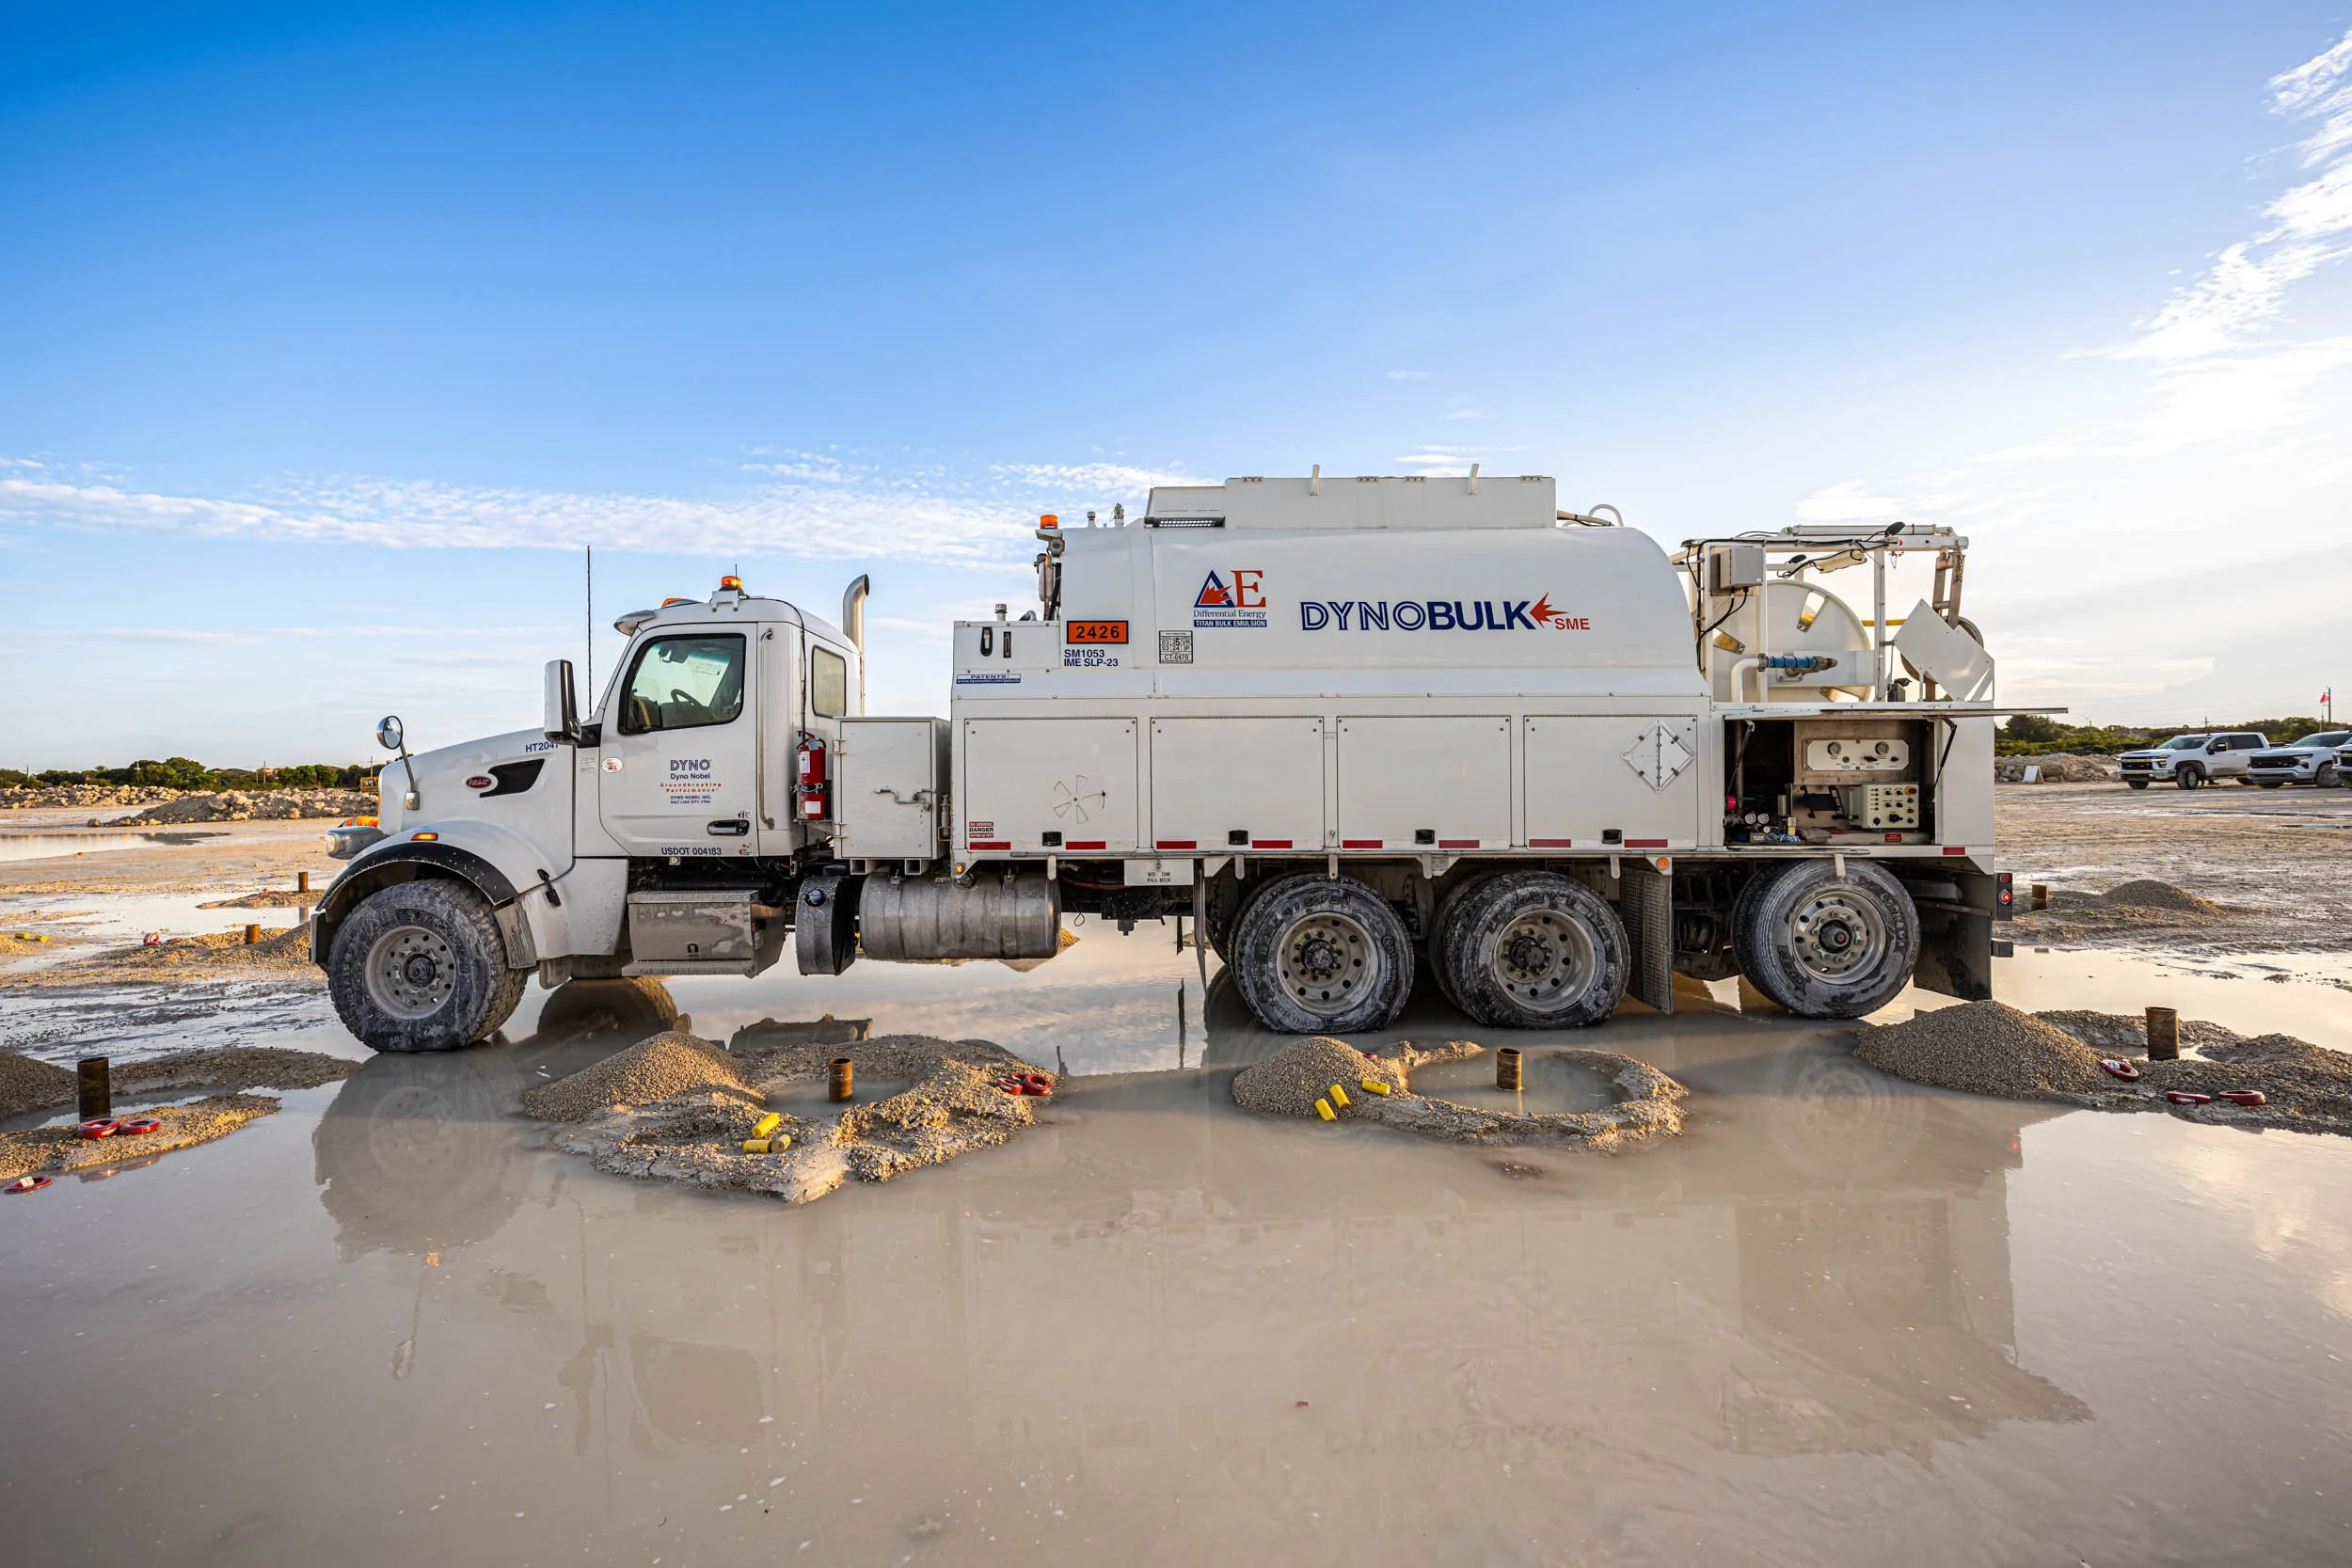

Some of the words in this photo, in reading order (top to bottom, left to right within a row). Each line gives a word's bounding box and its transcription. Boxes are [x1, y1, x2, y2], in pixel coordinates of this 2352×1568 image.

[1193, 610, 1237, 618] Differential
[1238, 610, 1266, 619] Energy
[1299, 600, 1537, 631] DYNOBULK
[1554, 617, 1591, 630] SME
[1075, 625, 1120, 639] 2426
[1063, 648, 1105, 658] SM1053
[1063, 657, 1082, 667] IME
[1083, 657, 1119, 667] SLP-23
[670, 759, 711, 771] DYNO
[670, 772, 689, 781] Dyno
[660, 847, 690, 855] USDOT
[691, 847, 723, 855] 004183
